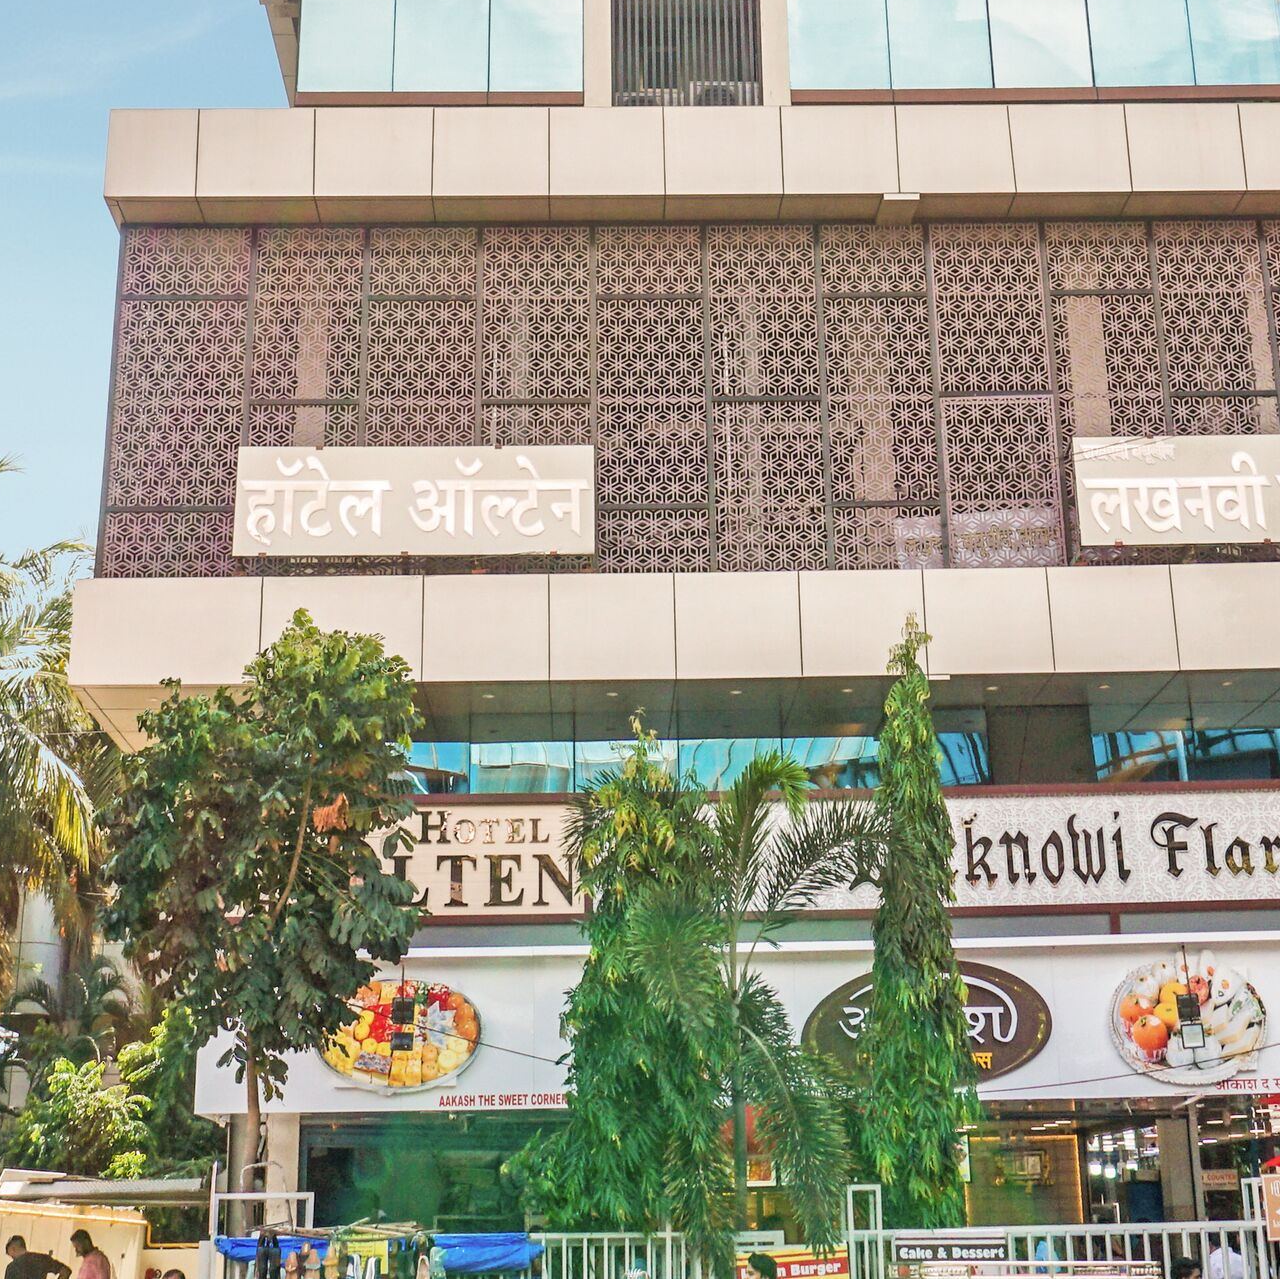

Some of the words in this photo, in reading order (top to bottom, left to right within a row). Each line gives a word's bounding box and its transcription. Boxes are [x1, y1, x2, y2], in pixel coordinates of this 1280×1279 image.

[239, 455, 393, 546] हॉटेल
[408, 455, 593, 537] ऑल्टेन
[1081, 450, 1272, 533] लखनवी
[418, 810, 550, 845] HOTEL
[953, 810, 1132, 888] knowi
[391, 854, 578, 907] LTEN
[439, 1095, 476, 1107] AAKASH
[478, 1094, 496, 1106] THE
[498, 1094, 528, 1106] SWEET
[790, 1261, 841, 1276] Burger
[899, 1247, 933, 1260] Cake
[937, 1246, 948, 1260] &
[952, 1246, 1005, 1259] Dessert
